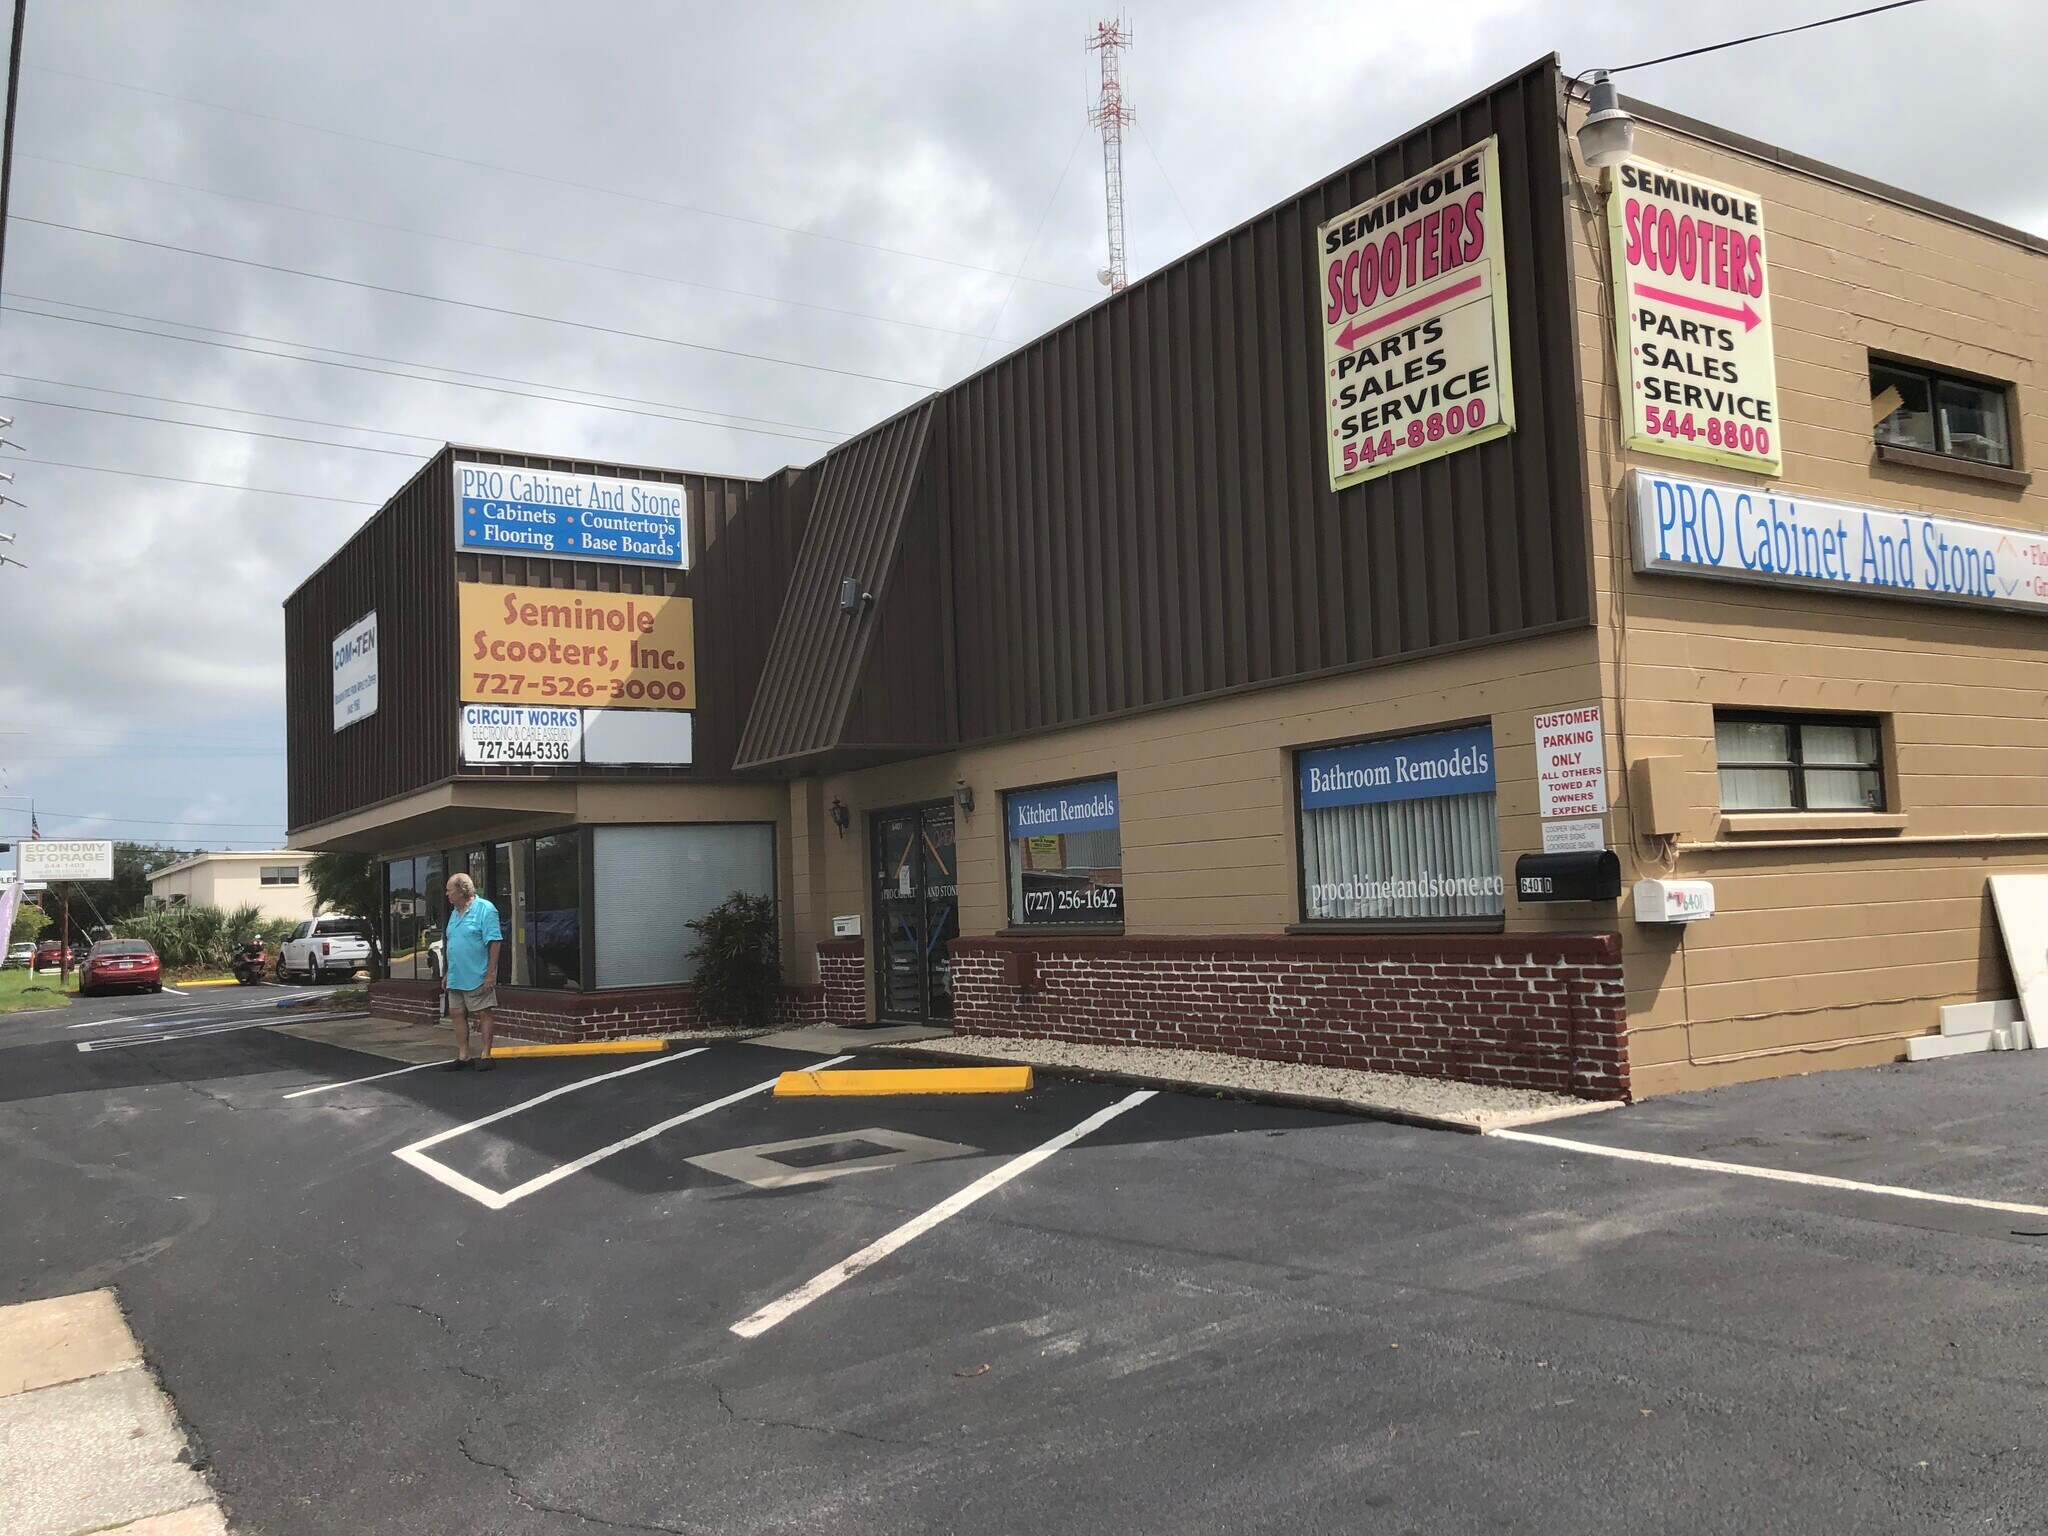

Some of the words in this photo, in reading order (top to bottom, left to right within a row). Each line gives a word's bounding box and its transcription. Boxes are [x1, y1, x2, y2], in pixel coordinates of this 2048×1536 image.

[1326, 158, 1480, 254] SEMINOLE
[1621, 164, 1758, 226] SEMINOLE
[1328, 191, 1484, 324] SCOOTERS
[1625, 198, 1763, 298] SCOOTERS
[1639, 308, 1734, 351] PARTS
[1338, 318, 1443, 380] PARTS
[1641, 343, 1738, 384] SALES
[1339, 349, 1447, 409] SALES
[1341, 366, 1490, 440] SERVICE
[1643, 376, 1772, 423] SERVICE
[1343, 398, 1485, 471] 544-8800
[1645, 405, 1769, 455] 544-8800
[463, 469, 503, 499] PRO
[510, 474, 582, 506] Cabinet
[588, 482, 624, 511] And
[631, 486, 681, 517] Stone
[483, 503, 556, 524] Cabinets
[581, 511, 675, 538] Countertops
[484, 524, 554, 550] Flooring
[582, 532, 617, 551] Base
[622, 536, 674, 556] Boards
[1653, 480, 1725, 566] PRO
[1735, 493, 1851, 582] Cabinet
[1859, 512, 1915, 589] And
[1922, 521, 1996, 598] Stone
[504, 592, 654, 634] Seminole
[334, 627, 375, 671] COM-TEN
[473, 630, 619, 672] Scooters,
[630, 639, 685, 671] Inc.
[473, 672, 686, 701] 727-526-3000
[467, 709, 524, 725] CIRCUIT
[528, 710, 577, 727] WORKS
[472, 726, 513, 740] ELECTRONIC
[521, 727, 541, 741] CABLE
[1536, 709, 1599, 729] CUSTOMER
[478, 741, 569, 759] 727-544-5336
[1543, 730, 1594, 748] PARKING
[1310, 764, 1391, 793] Bathroom
[1395, 745, 1489, 783] Remodels
[1541, 772, 1559, 781] ALL
[1562, 766, 1602, 778] OTHERS
[1552, 752, 1581, 767] ONLY
[1548, 781, 1583, 791] TOWED
[1585, 779, 1598, 788] AT
[1551, 792, 1594, 803] OWNERS
[1019, 803, 1058, 826] Kitchen
[1060, 794, 1114, 821] Remodels
[1552, 804, 1598, 815] EXPENCE
[25, 843, 105, 852] ECONOMY
[25, 853, 104, 862] STORAGE
[927, 886, 939, 897] AND
[1025, 891, 1055, 915] (727)
[1058, 888, 1117, 909] 256-1642
[1521, 878, 1544, 893] 6401
